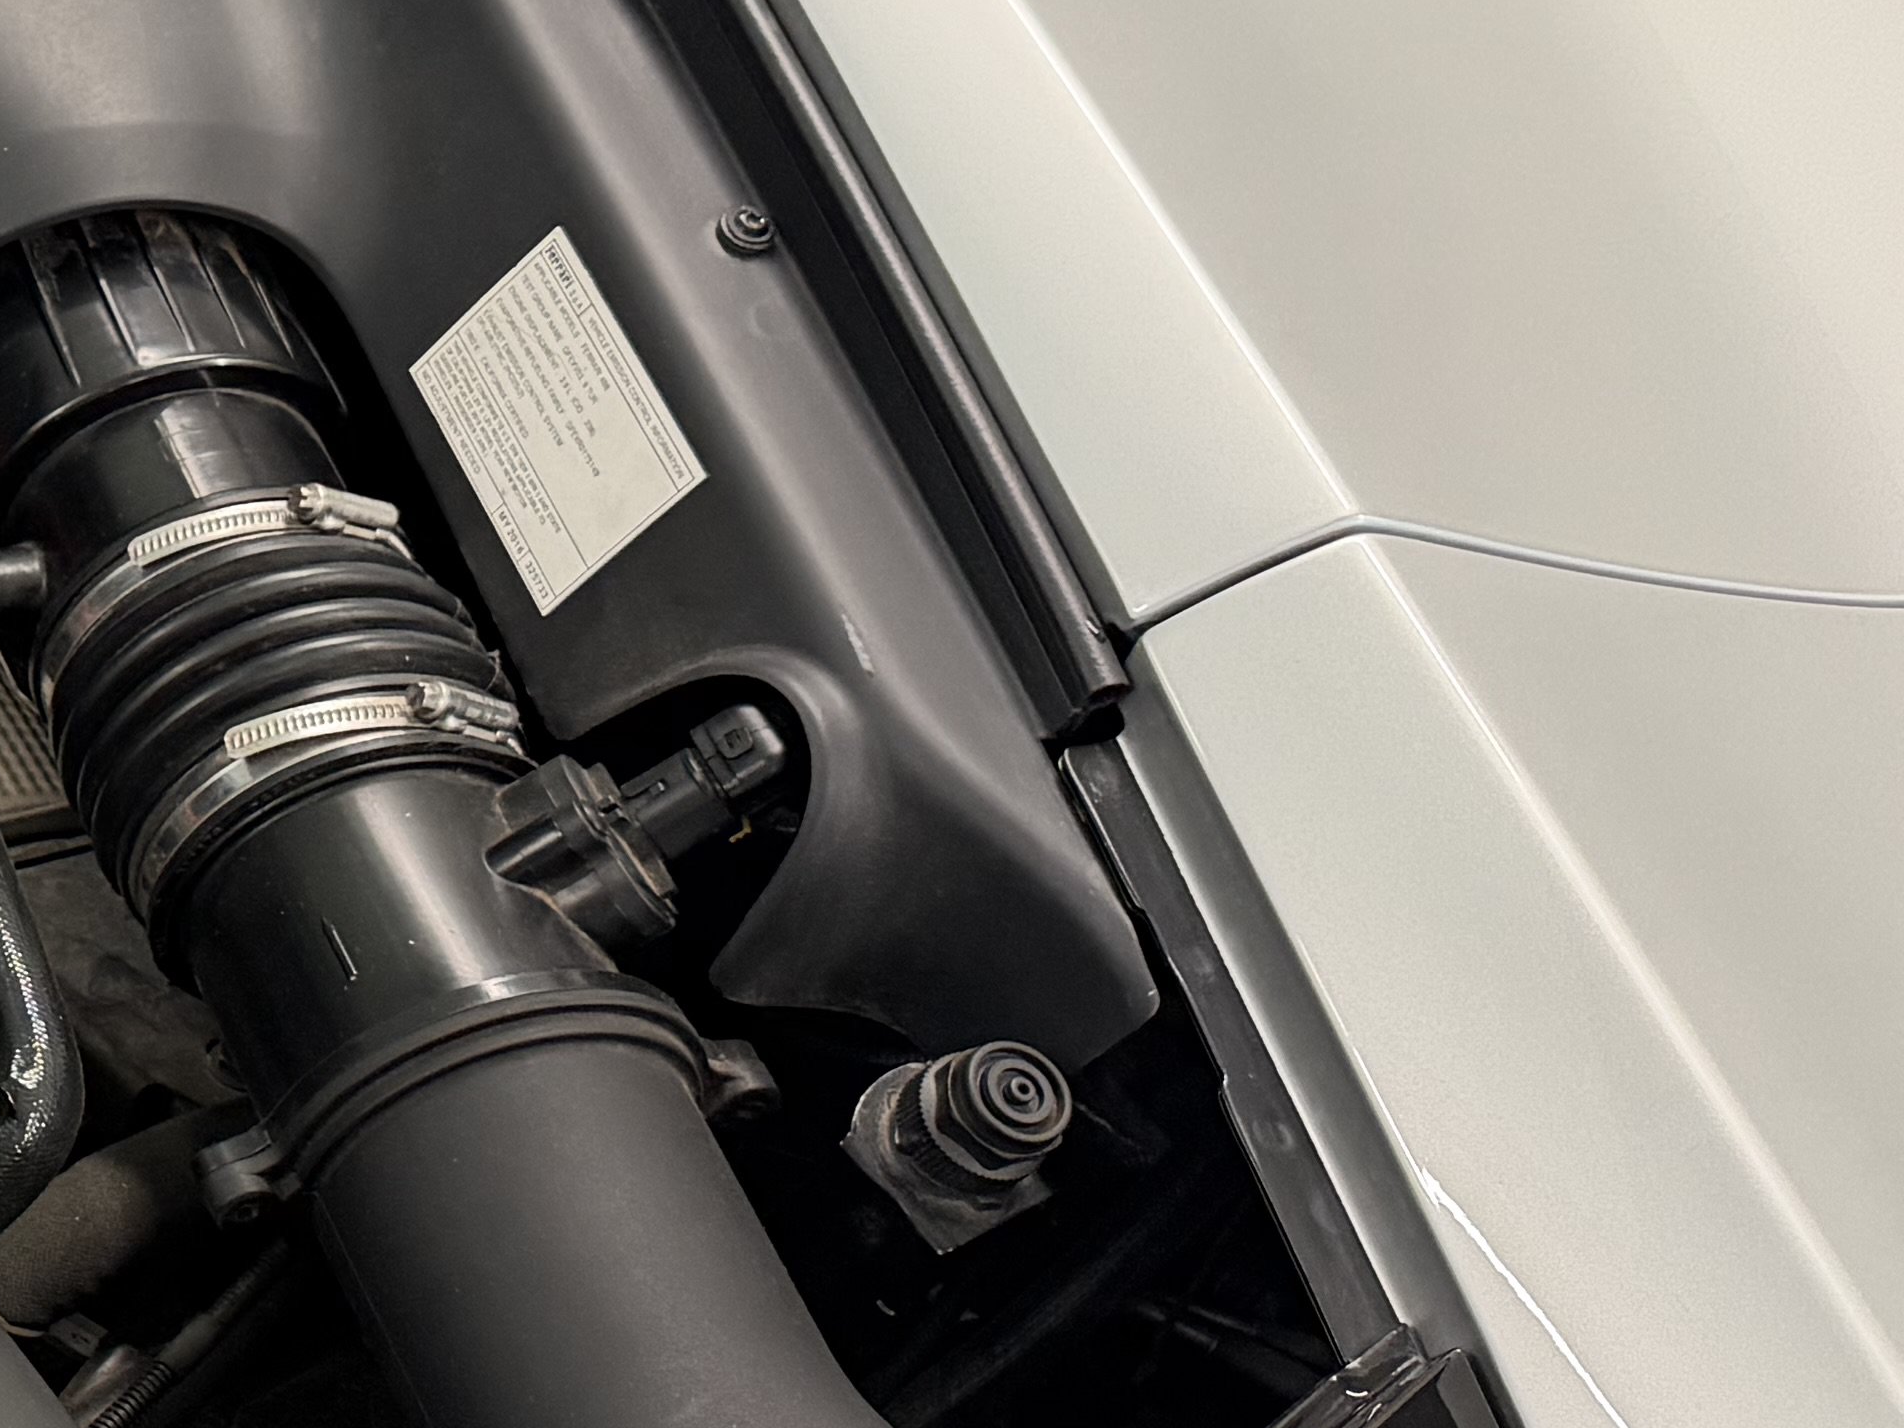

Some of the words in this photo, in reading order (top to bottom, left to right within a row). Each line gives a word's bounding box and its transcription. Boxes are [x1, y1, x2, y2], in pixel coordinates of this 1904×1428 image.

[543, 243, 575, 290] Ferrari
[605, 348, 631, 388] EMISSION
[626, 386, 653, 425] CONTROL
[648, 423, 685, 480] INFORMATION
[496, 510, 511, 530] MY
[506, 527, 525, 556] 2016
